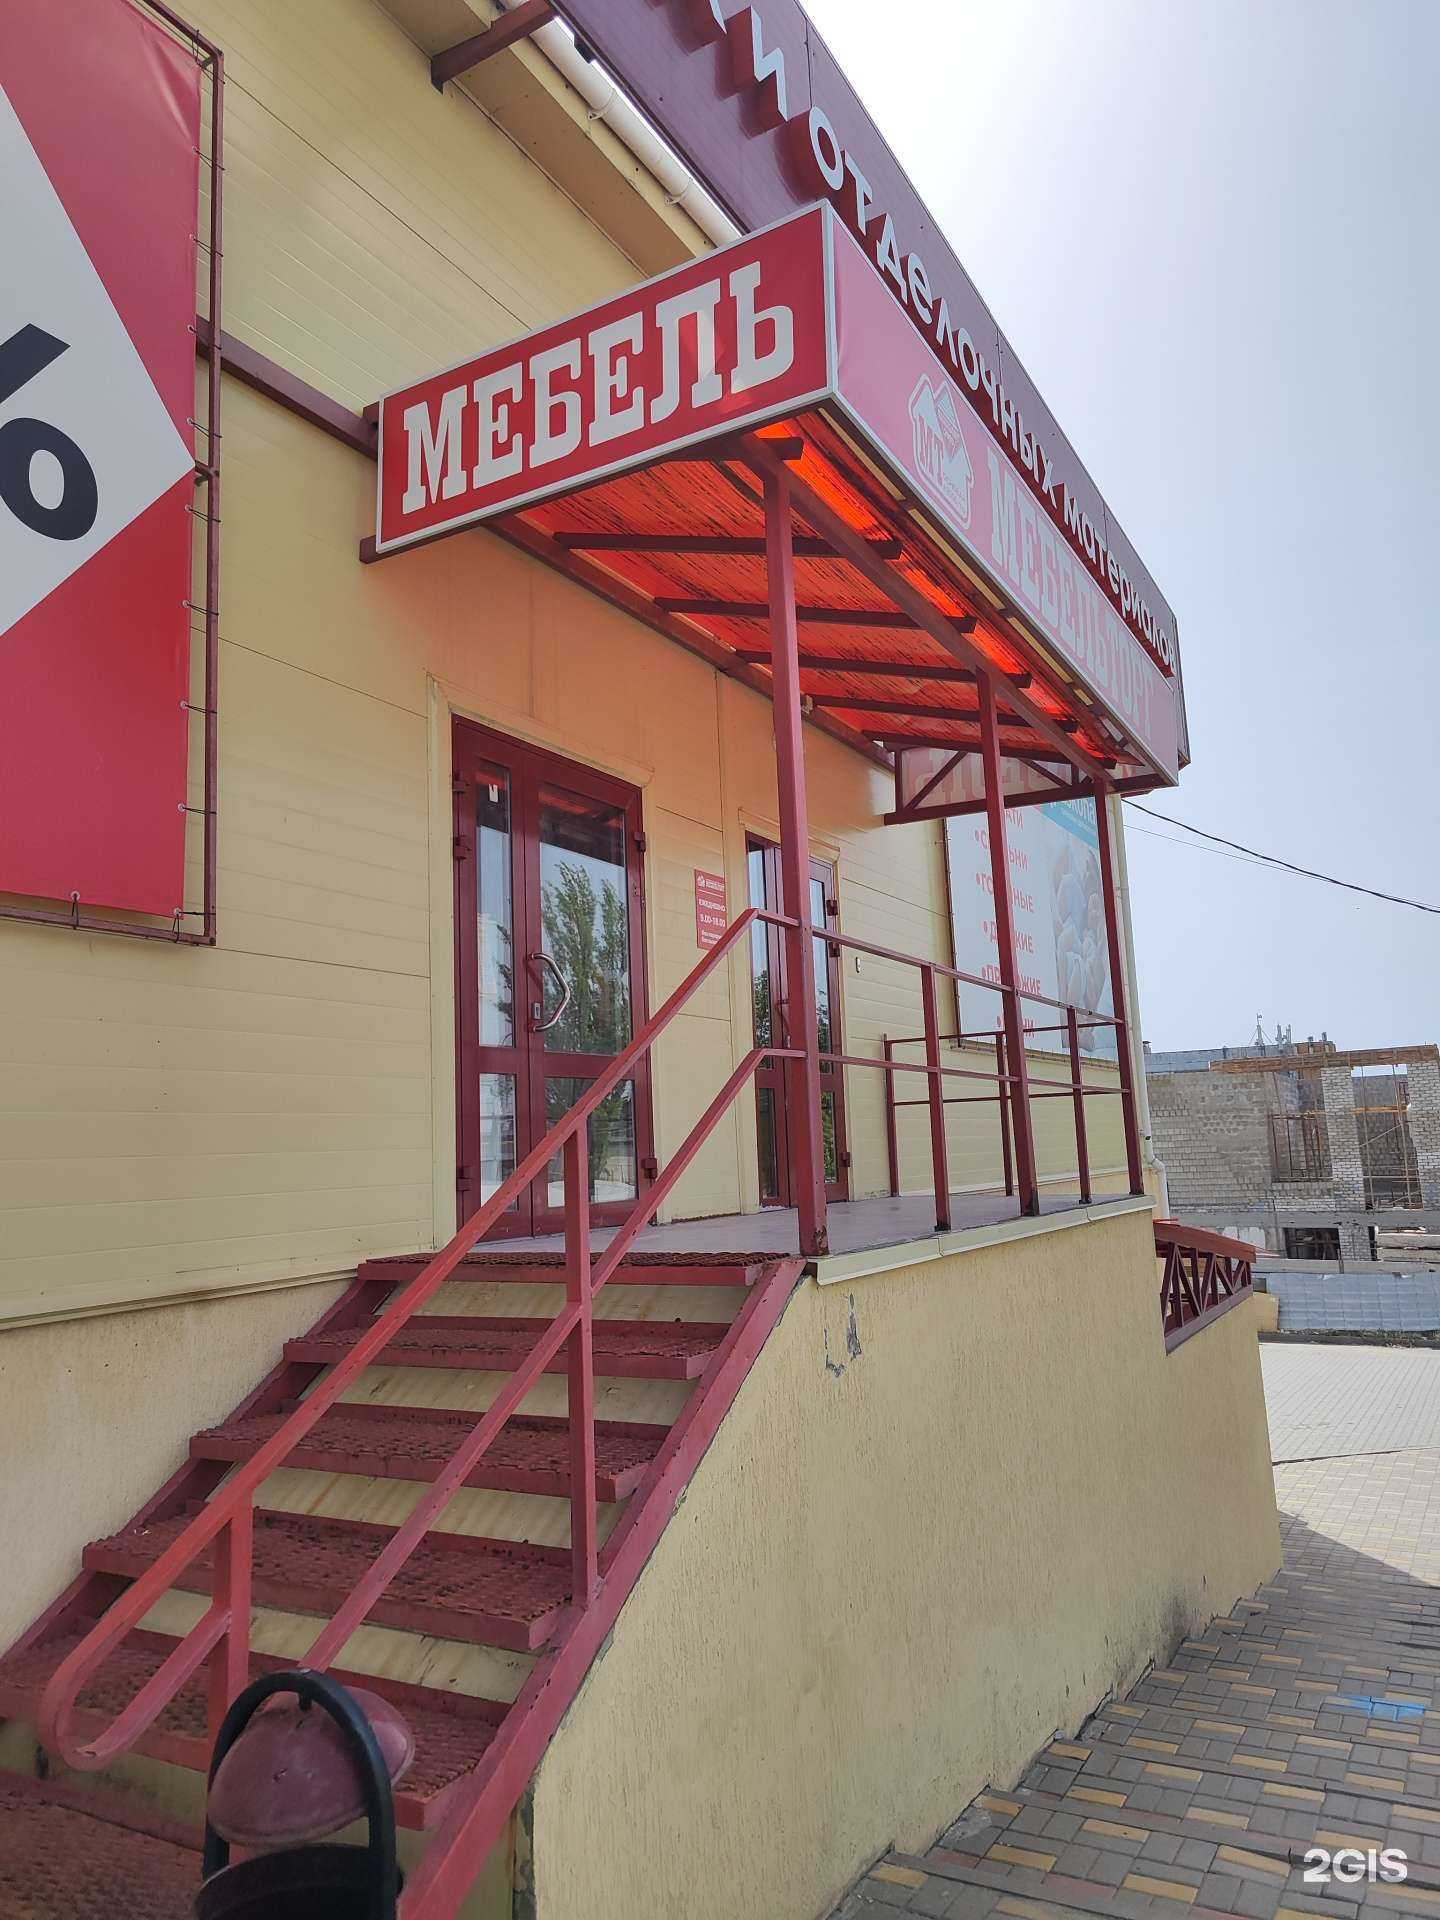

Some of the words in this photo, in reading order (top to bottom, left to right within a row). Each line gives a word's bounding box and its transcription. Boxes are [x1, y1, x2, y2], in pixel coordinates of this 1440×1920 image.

[402, 260, 794, 514] МЕБЕЛЬ
[809, 106, 1057, 509] отделочных
[987, 445, 1153, 725] МЕБЕЛЬТОРГ
